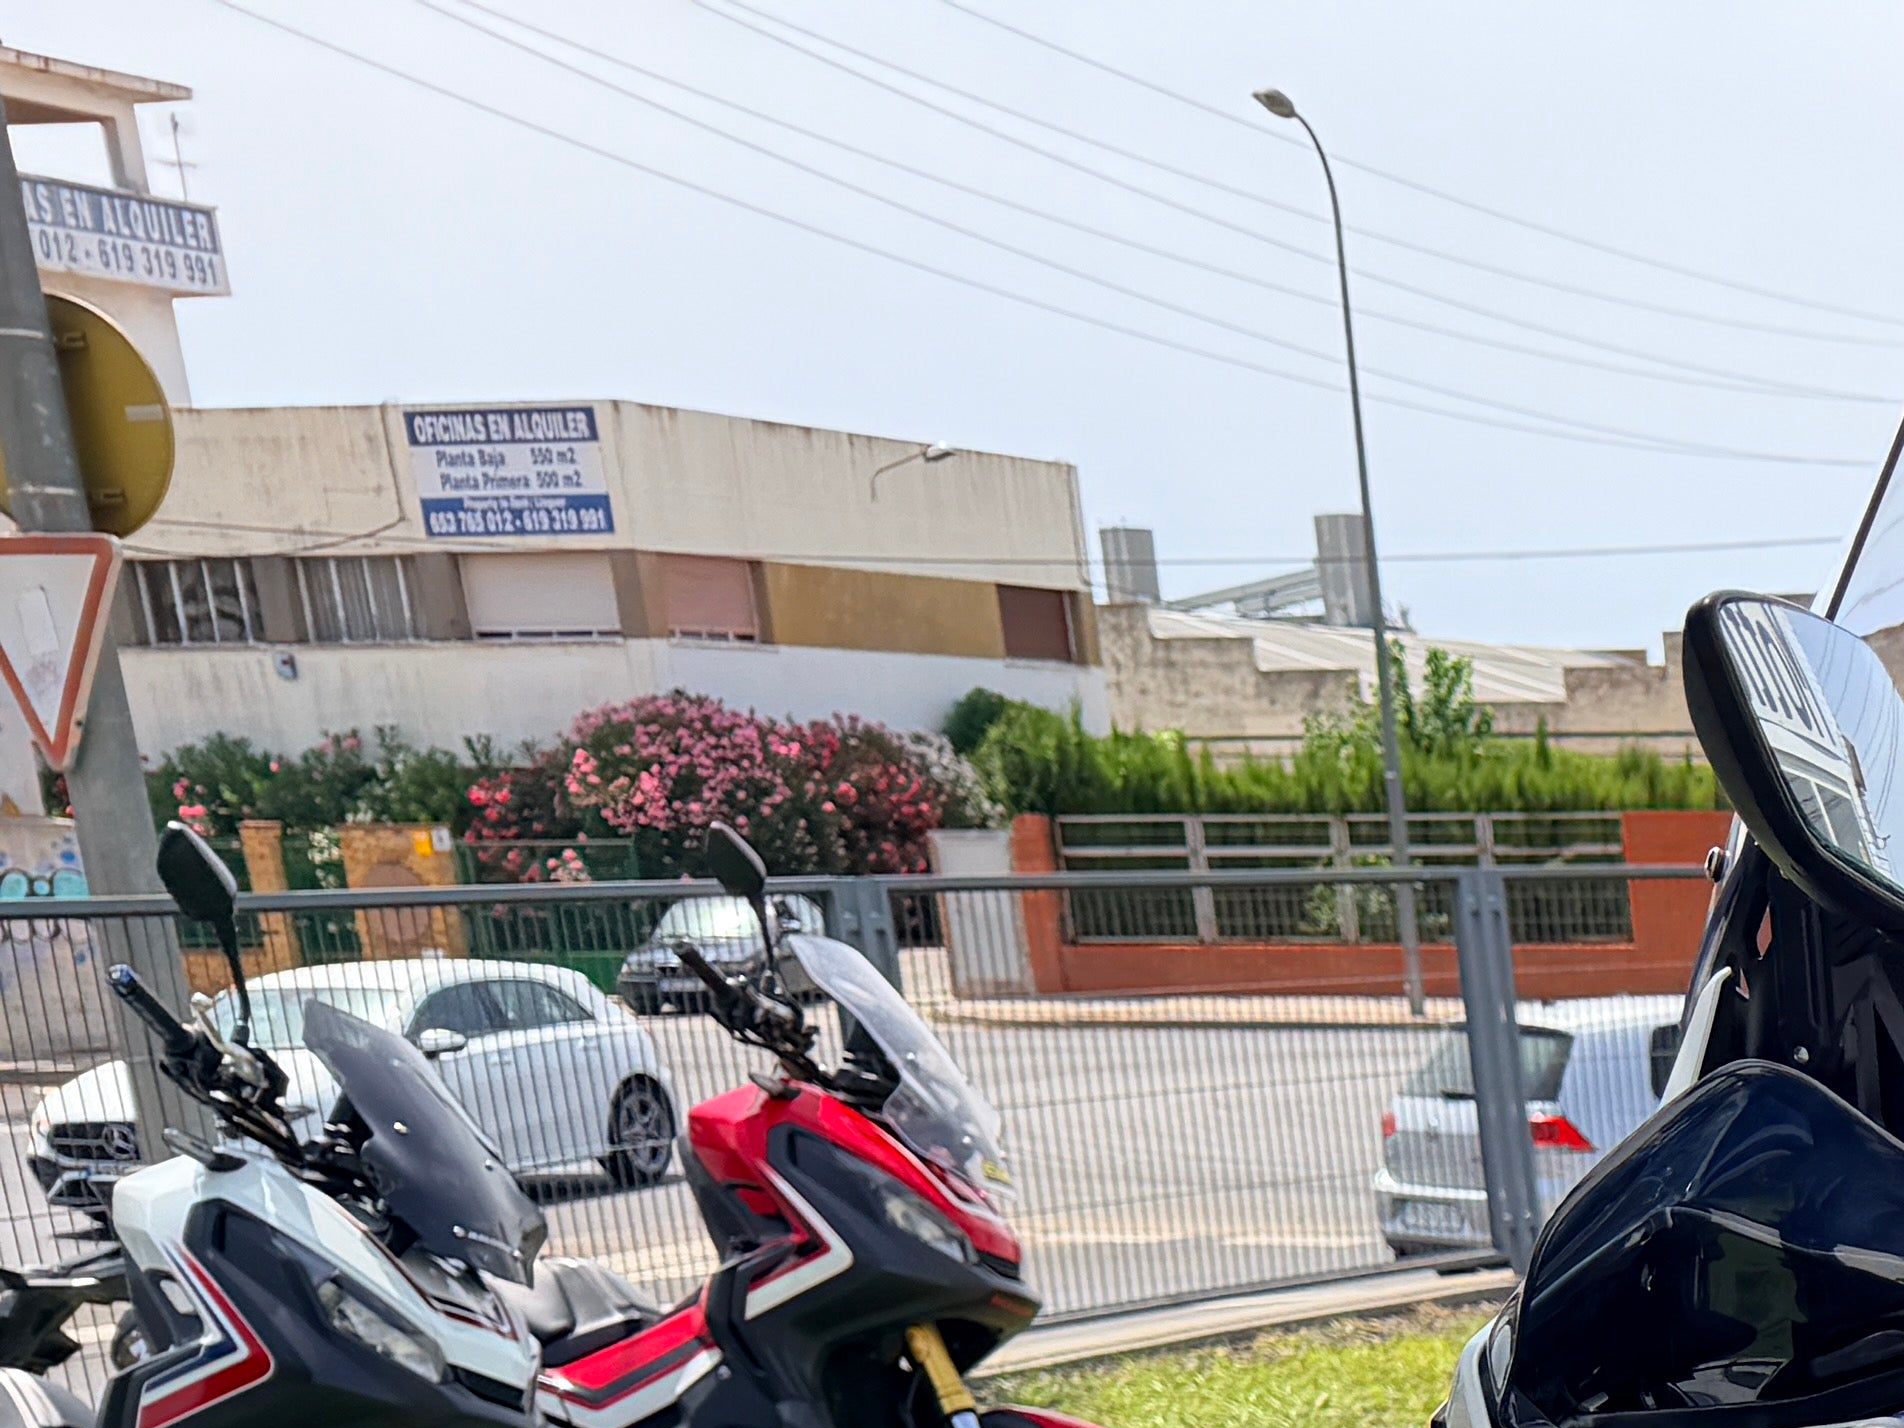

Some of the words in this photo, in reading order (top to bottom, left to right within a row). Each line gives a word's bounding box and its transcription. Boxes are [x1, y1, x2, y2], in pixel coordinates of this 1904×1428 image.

[59, 187, 95, 229] EN
[100, 195, 214, 250] ALQUILER
[39, 228, 78, 263] 012
[98, 238, 134, 273] 619
[140, 246, 177, 280] 319
[183, 253, 218, 286] 991
[413, 411, 486, 443] OFICINAS
[486, 413, 512, 442] EN
[513, 410, 590, 441] ALQUILER
[436, 449, 475, 468] Planta
[477, 448, 506, 471] Baja
[556, 447, 577, 464] m2
[440, 472, 479, 491] Planta
[482, 470, 530, 490] Primera
[562, 469, 583, 487] m2
[486, 510, 515, 532] 012
[522, 509, 550, 532] 619
